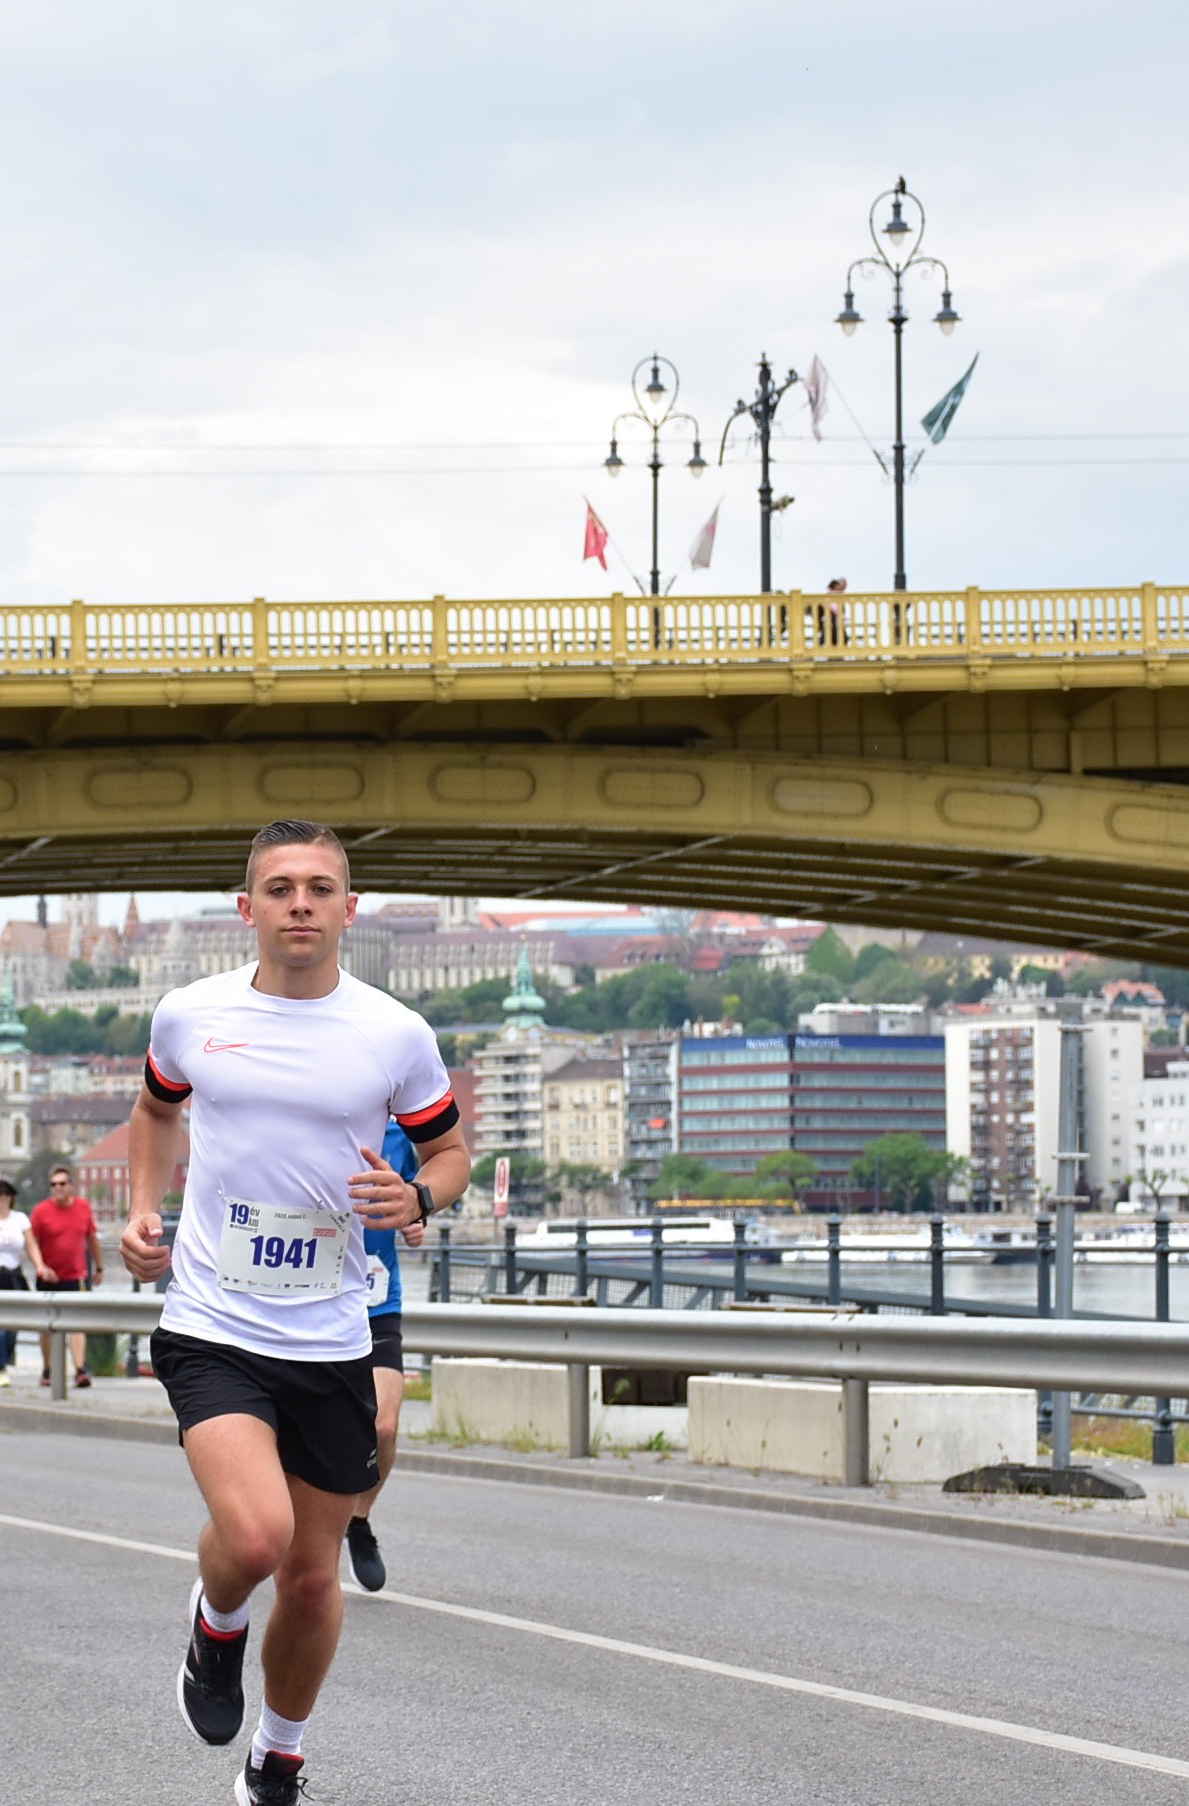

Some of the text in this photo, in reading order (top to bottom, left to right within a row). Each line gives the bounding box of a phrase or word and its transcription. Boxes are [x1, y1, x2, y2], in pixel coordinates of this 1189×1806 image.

[229, 1202, 250, 1225] 19
[248, 1217, 259, 1228] km
[250, 1234, 318, 1269] 1941
[365, 1272, 375, 1290] 5
